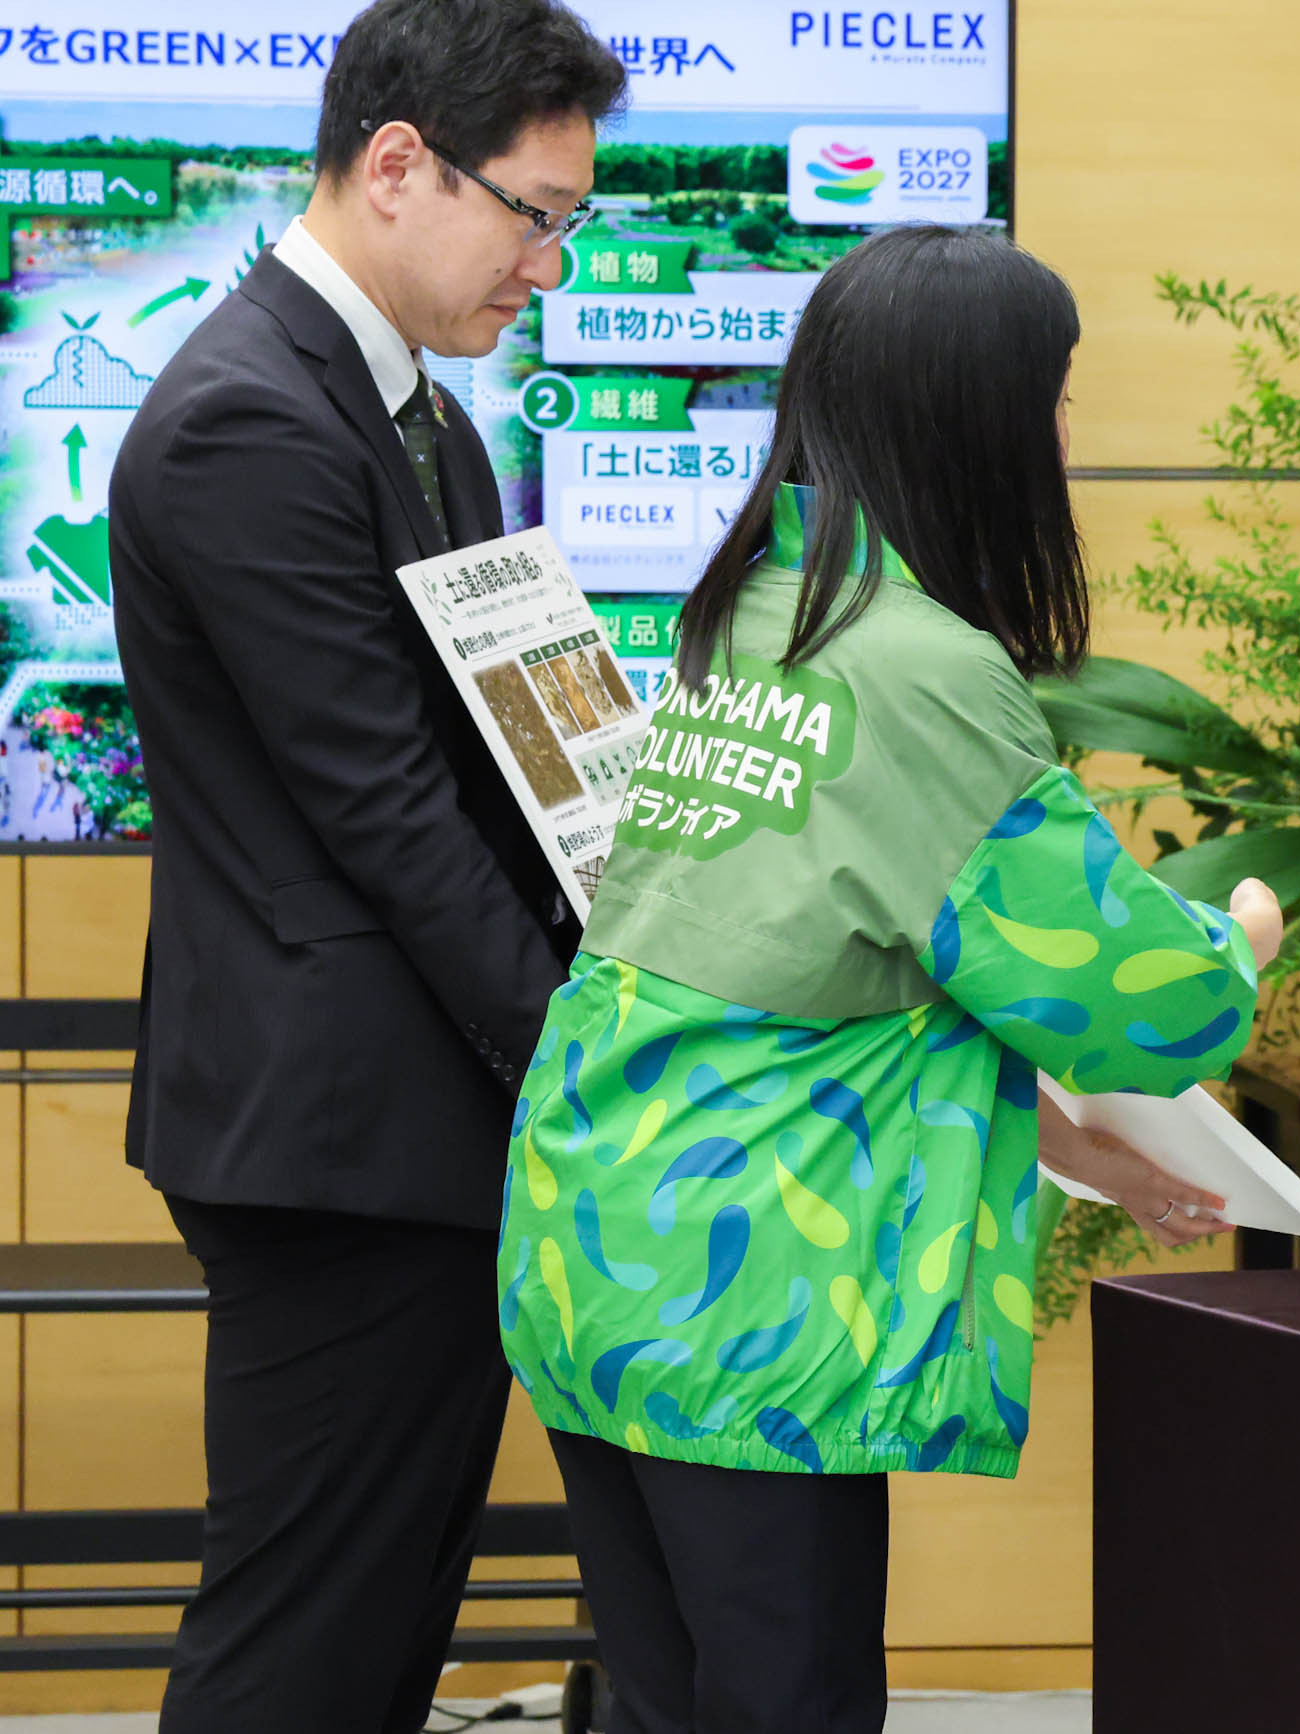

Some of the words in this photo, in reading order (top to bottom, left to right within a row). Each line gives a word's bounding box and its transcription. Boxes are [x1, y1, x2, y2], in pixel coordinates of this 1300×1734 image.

[791, 12, 985, 49] PIECLEX
[0, 26, 342, 68] をGREEN×EX
[611, 37, 735, 76] 世界へ
[899, 148, 972, 169] EXPO
[0, 169, 158, 205] 源循環へ。
[898, 170, 972, 190] 2027
[588, 250, 659, 284] 植物
[576, 306, 801, 342] 植物から始ま
[535, 387, 559, 419] 2
[590, 389, 660, 422] 繊維
[582, 442, 770, 479] 「土に還る」
[581, 504, 676, 523] PIECLEX
